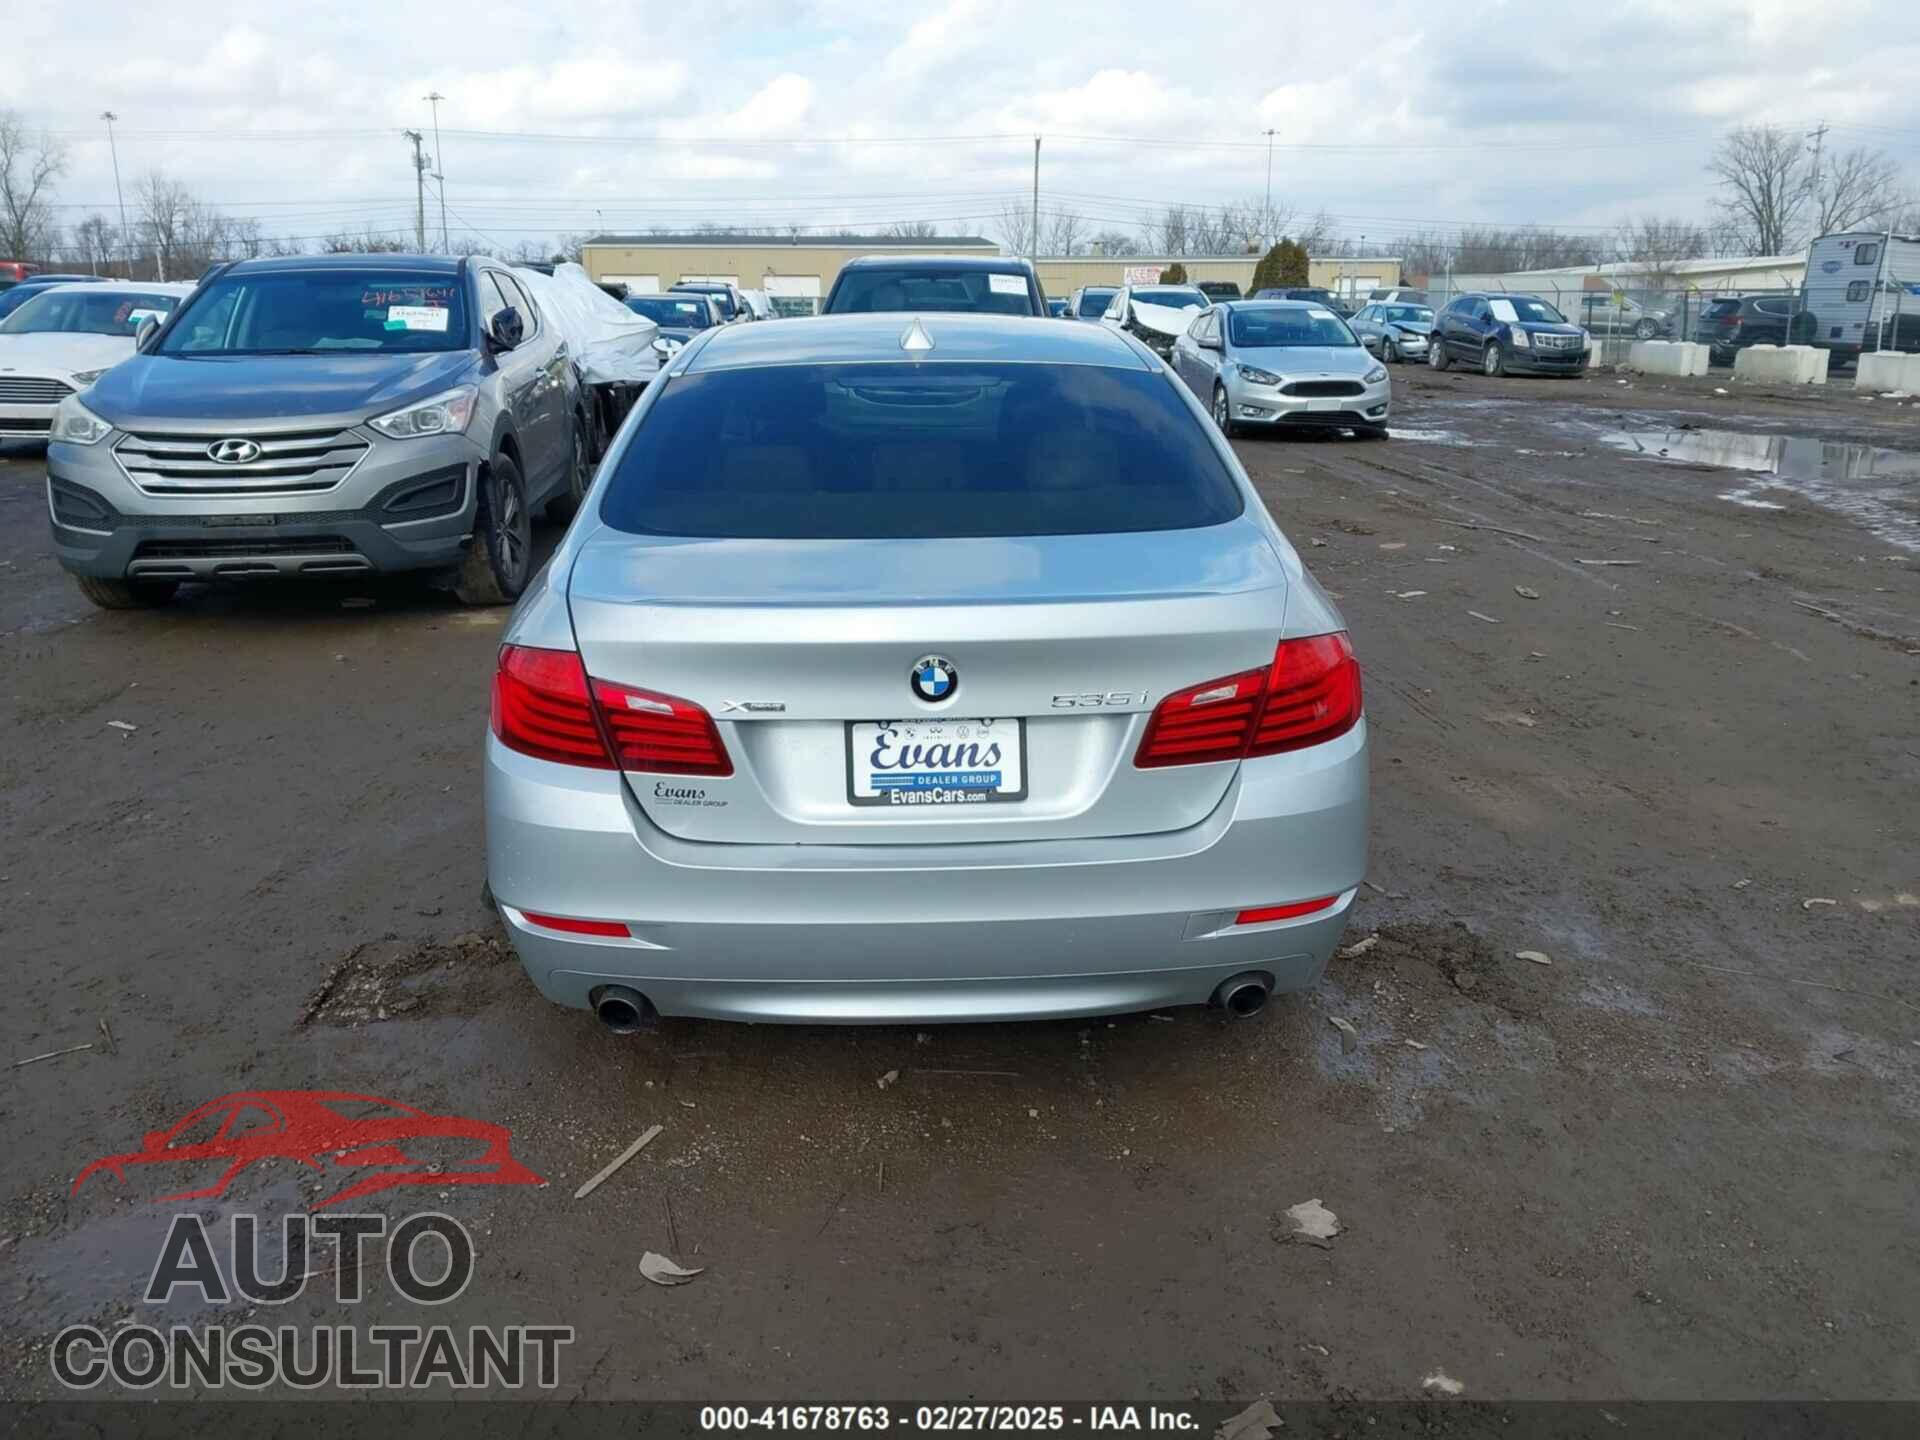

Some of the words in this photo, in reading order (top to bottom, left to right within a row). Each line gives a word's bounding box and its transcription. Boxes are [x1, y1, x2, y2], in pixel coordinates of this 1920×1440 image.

[1051, 689, 1149, 709] 535i
[870, 728, 1002, 770] Evans
[918, 776, 958, 786] DEALER
[961, 775, 997, 785] GROUP
[654, 781, 706, 800] Evans
[890, 787, 987, 805] EvansCars.com
